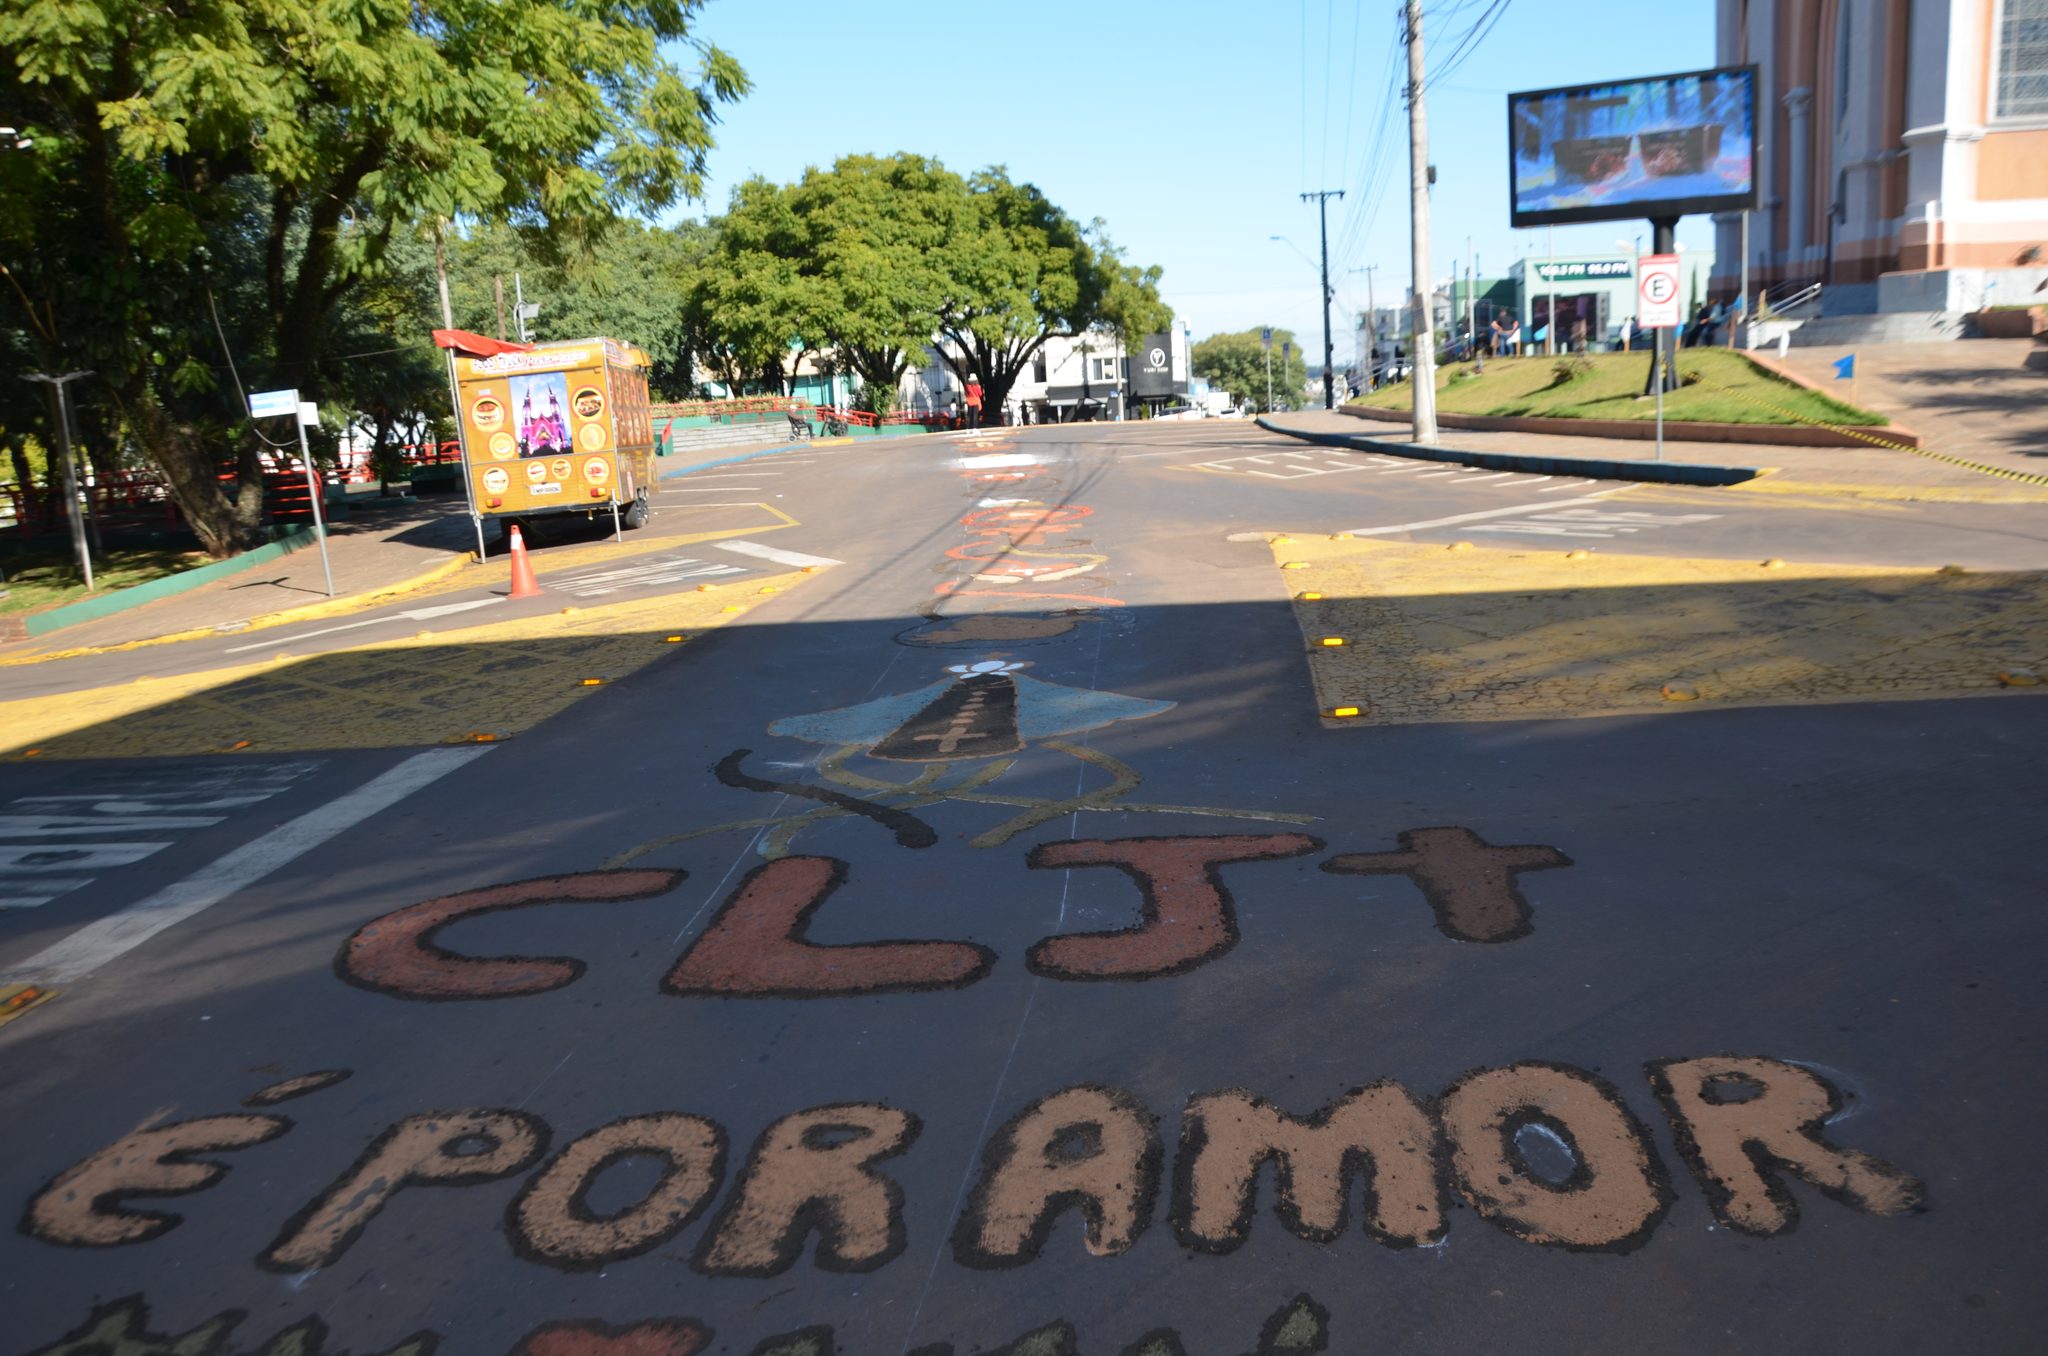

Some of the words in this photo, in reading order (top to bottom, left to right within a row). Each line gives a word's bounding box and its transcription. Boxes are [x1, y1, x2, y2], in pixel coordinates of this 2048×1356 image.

[1568, 265, 1585, 275] FM
[1611, 262, 1629, 274] FM
[1652, 278, 1665, 298] E
[255, 1101, 924, 1279] POR
[951, 1052, 1928, 1270] AMOR
